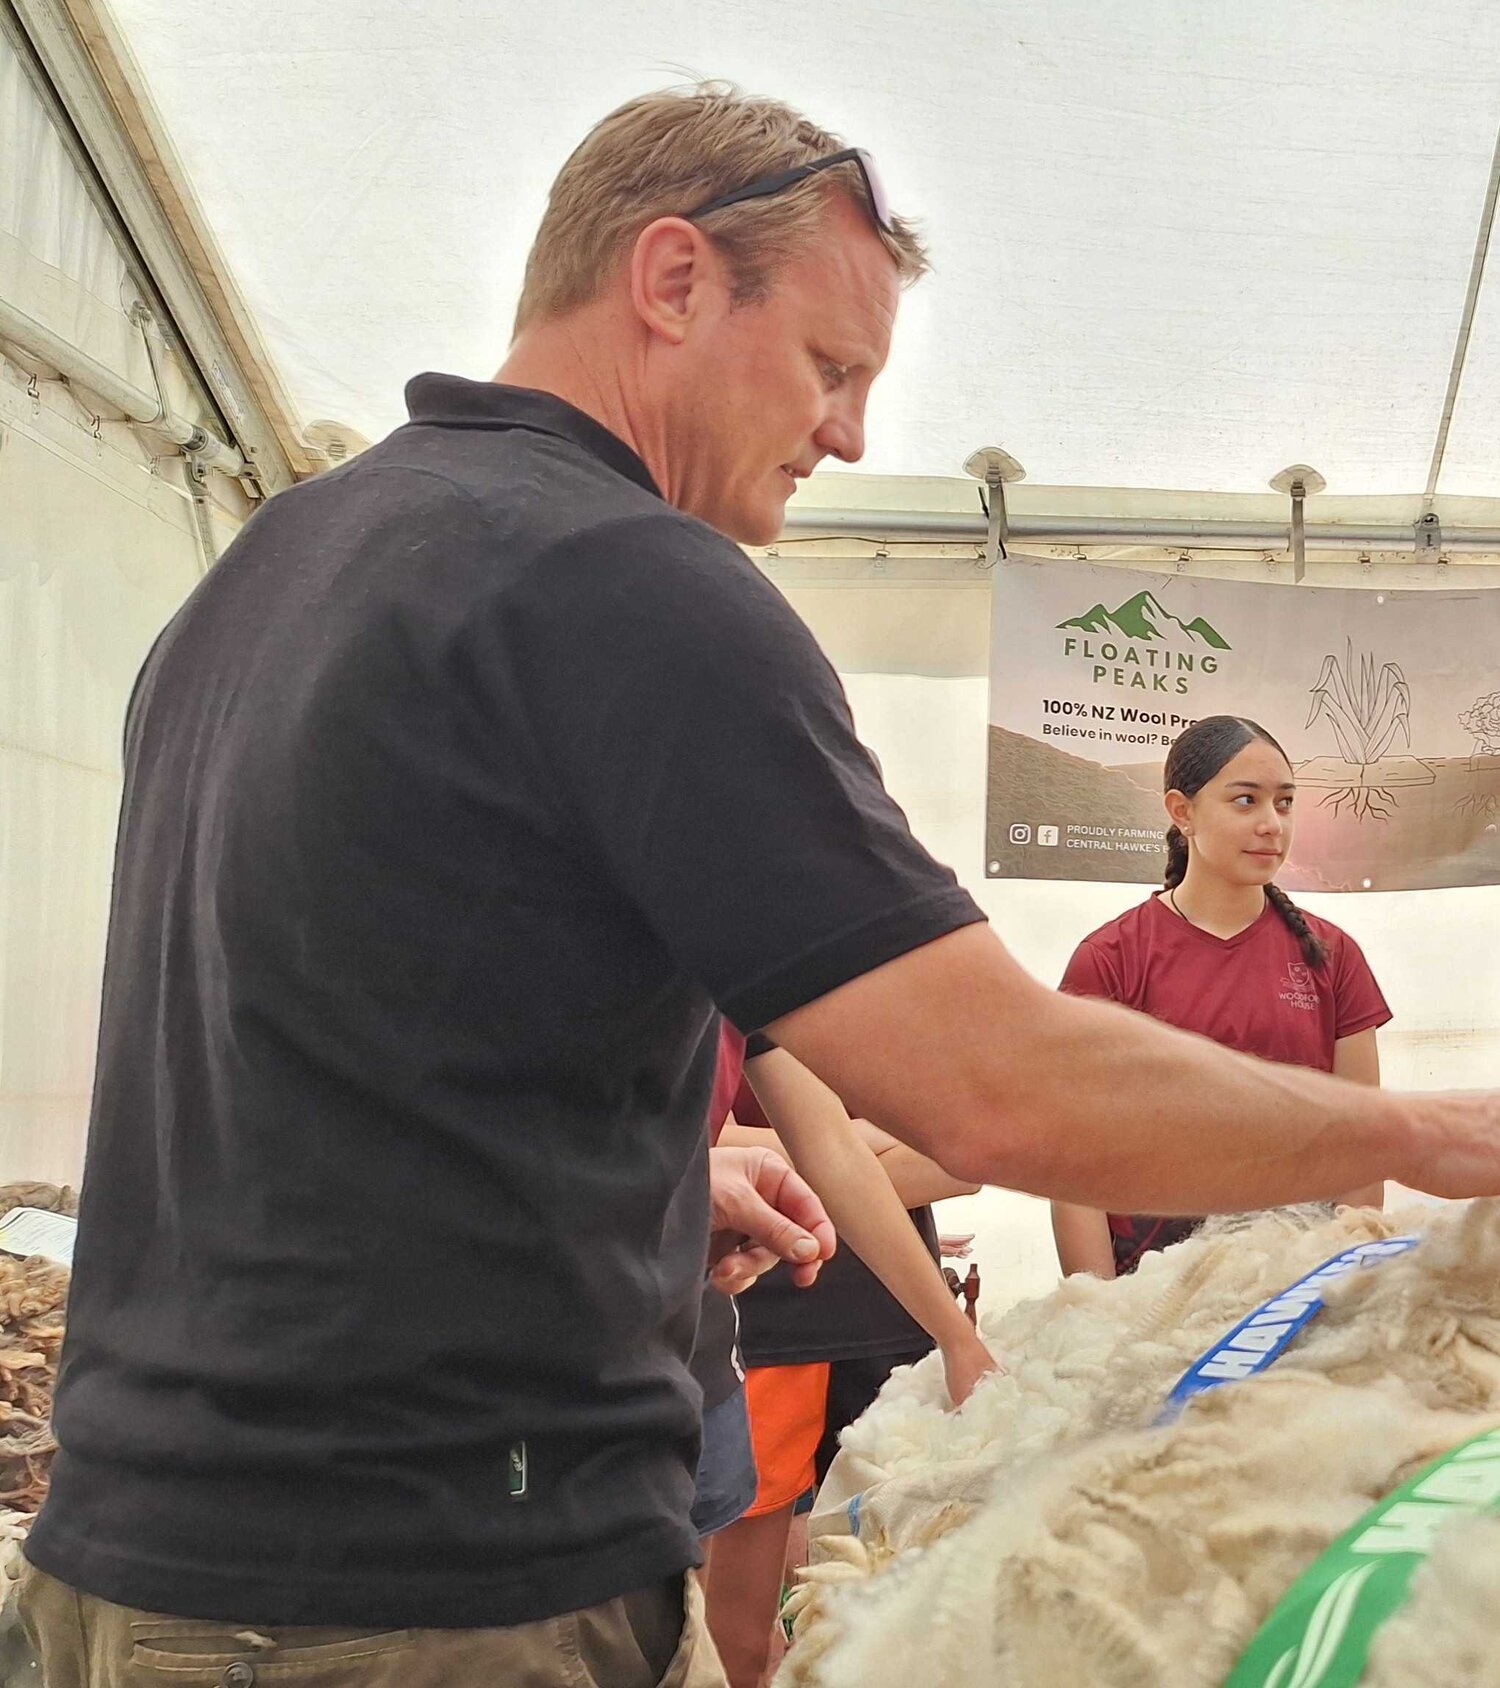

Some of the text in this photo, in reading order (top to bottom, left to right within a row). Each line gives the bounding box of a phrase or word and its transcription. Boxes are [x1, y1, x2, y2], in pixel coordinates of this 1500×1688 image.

[1064, 637, 1218, 674] FLOATING
[1092, 665, 1189, 695] PEAKS
[1042, 699, 1088, 718] 100%
[1091, 704, 1116, 721] NZ
[1120, 707, 1166, 726] Wool
[1042, 723, 1096, 740] Believe
[1099, 728, 1112, 742] in
[1115, 732, 1158, 745] wool?
[1066, 824, 1165, 840] PROUDLY FARMING
[1066, 838, 1113, 851] CENTRAL
[1115, 841, 1161, 853] HAWKE'S
